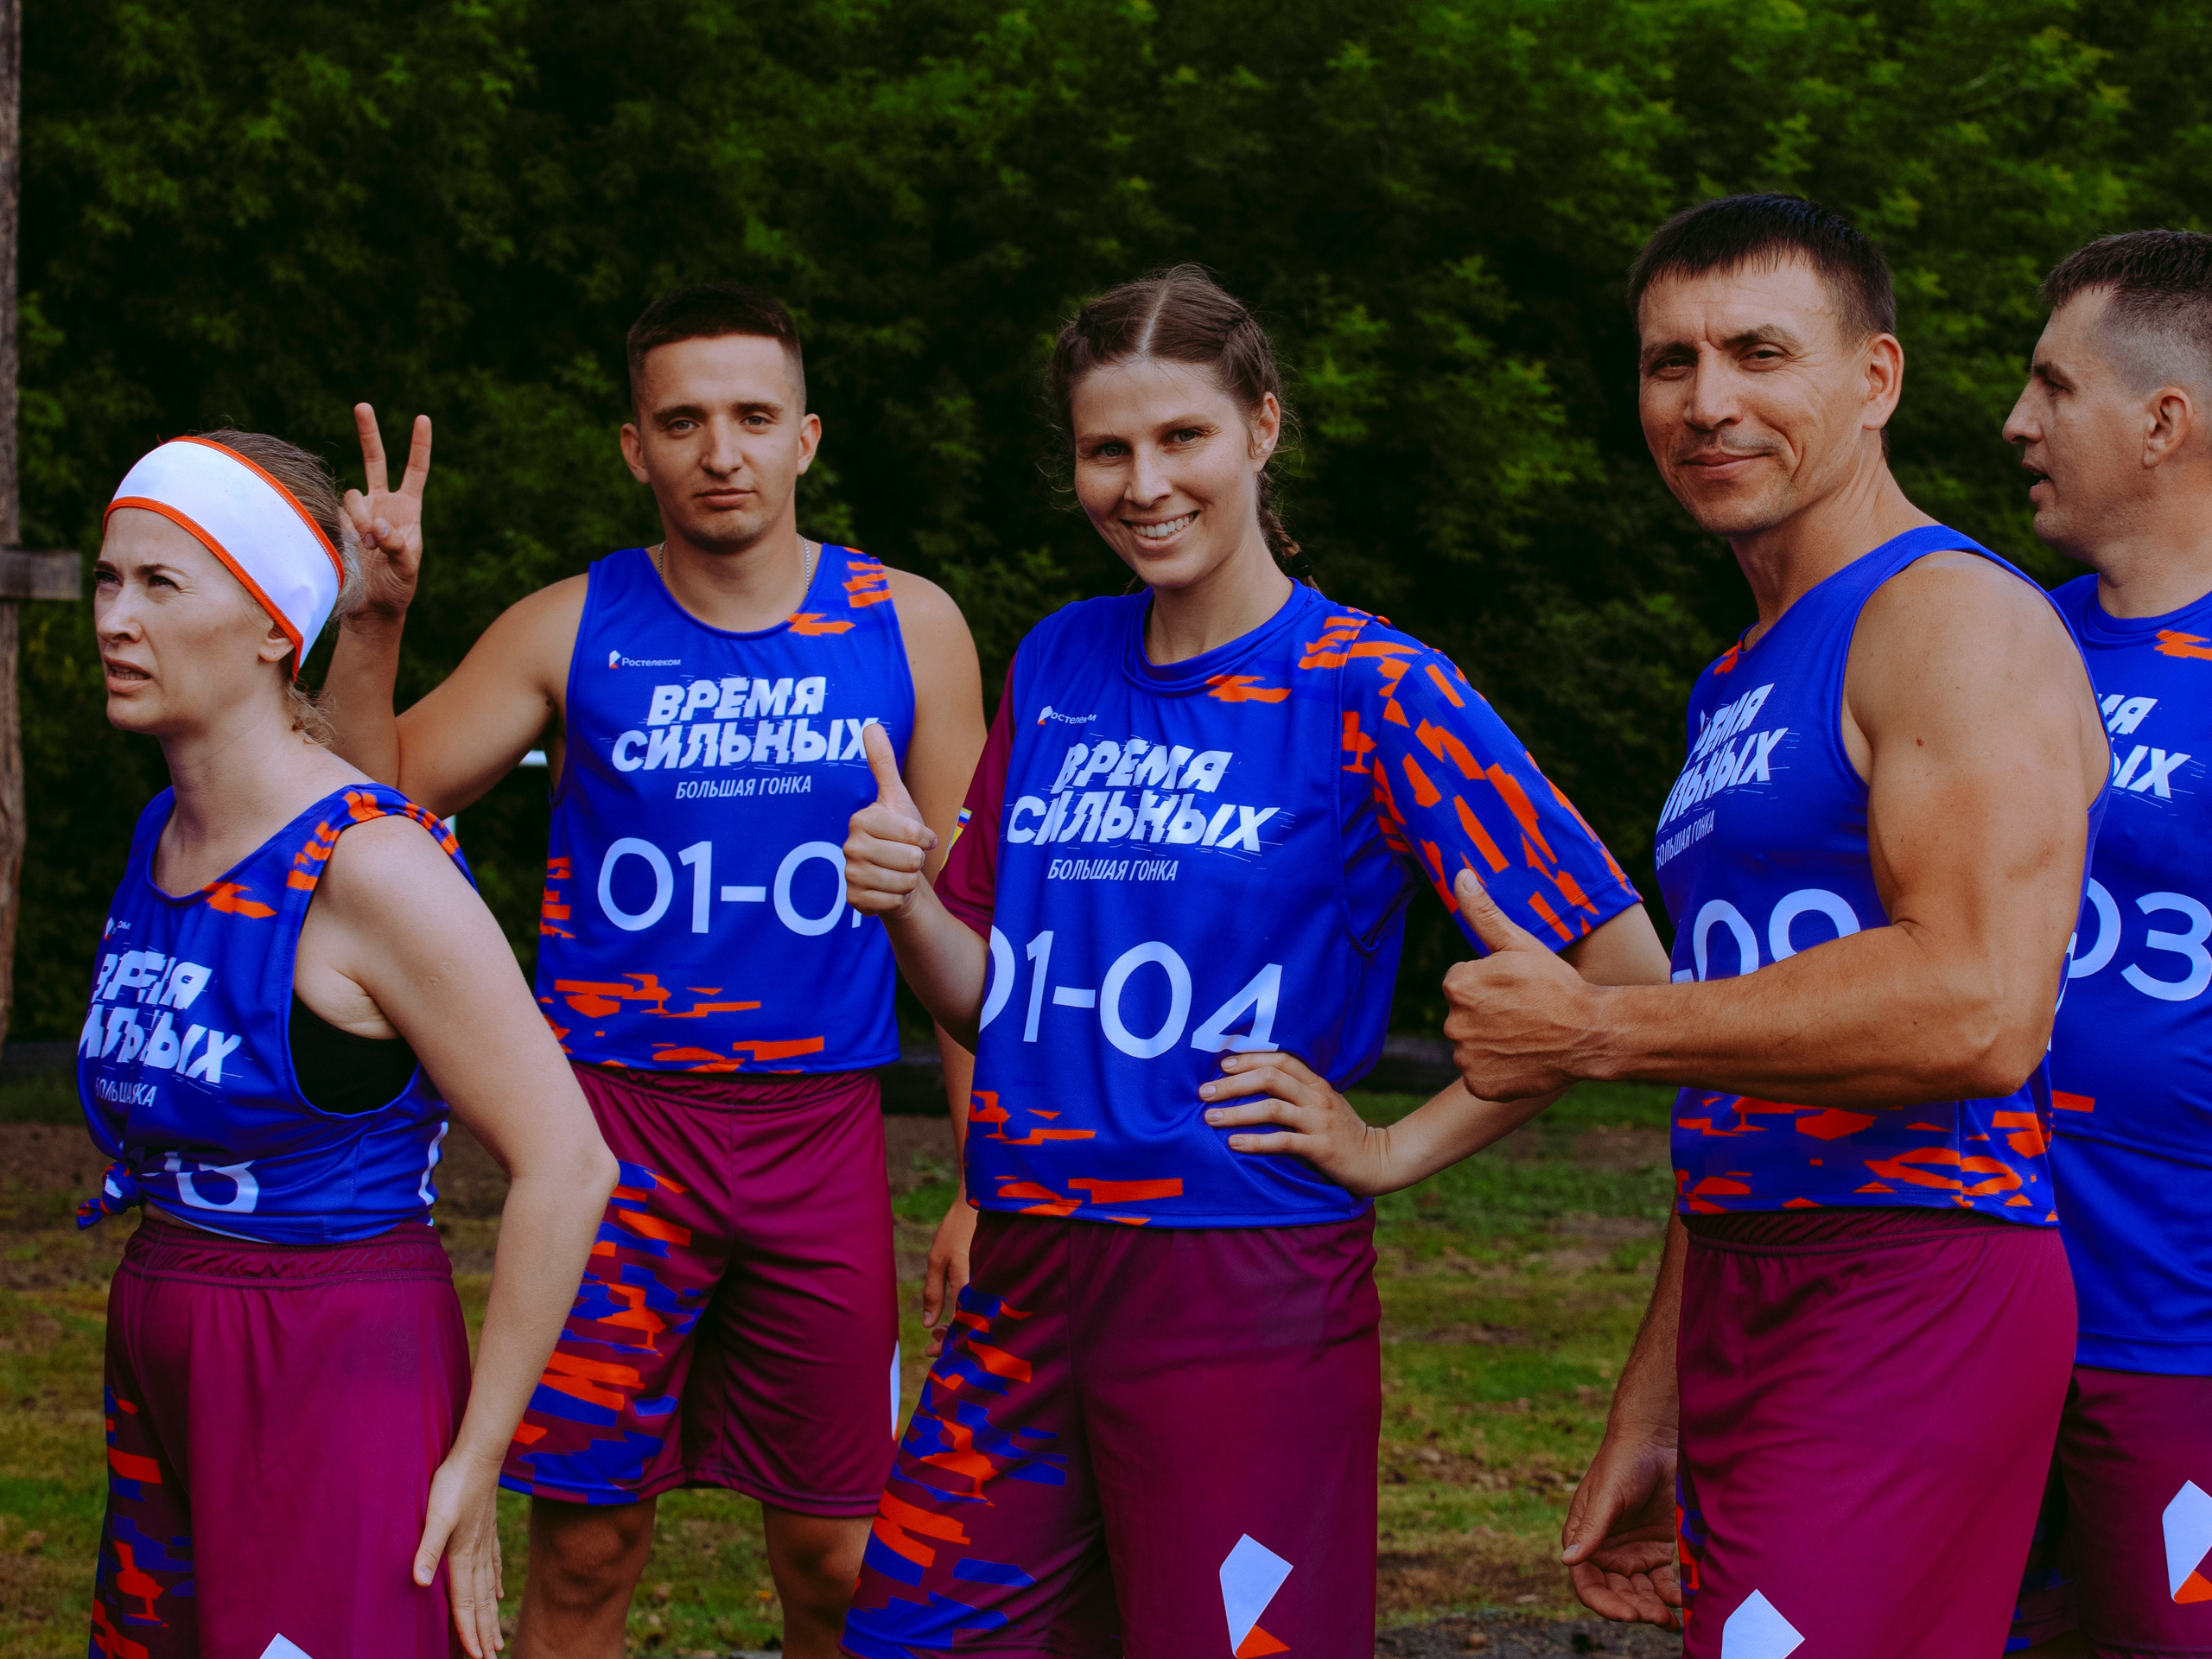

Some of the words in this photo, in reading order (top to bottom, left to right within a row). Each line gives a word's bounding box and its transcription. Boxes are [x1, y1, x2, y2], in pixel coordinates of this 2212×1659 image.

[622, 657, 681, 667] Ростелеком
[647, 677, 827, 727] ВРЕМЯ
[611, 717, 879, 772] СИЛЬНЫХ
[1051, 739, 1233, 794] ВРЕМЯ
[676, 778, 754, 799] БОЛЬШАЯ
[758, 775, 812, 796] ГОНКА
[1656, 824, 1692, 871] БОЛЬШАЯ
[1691, 810, 1715, 845] ГОНКА
[597, 836, 863, 937] 01-0
[1047, 859, 1128, 880] БОЛЬШАЯ
[1128, 860, 1179, 881] ГОНКА
